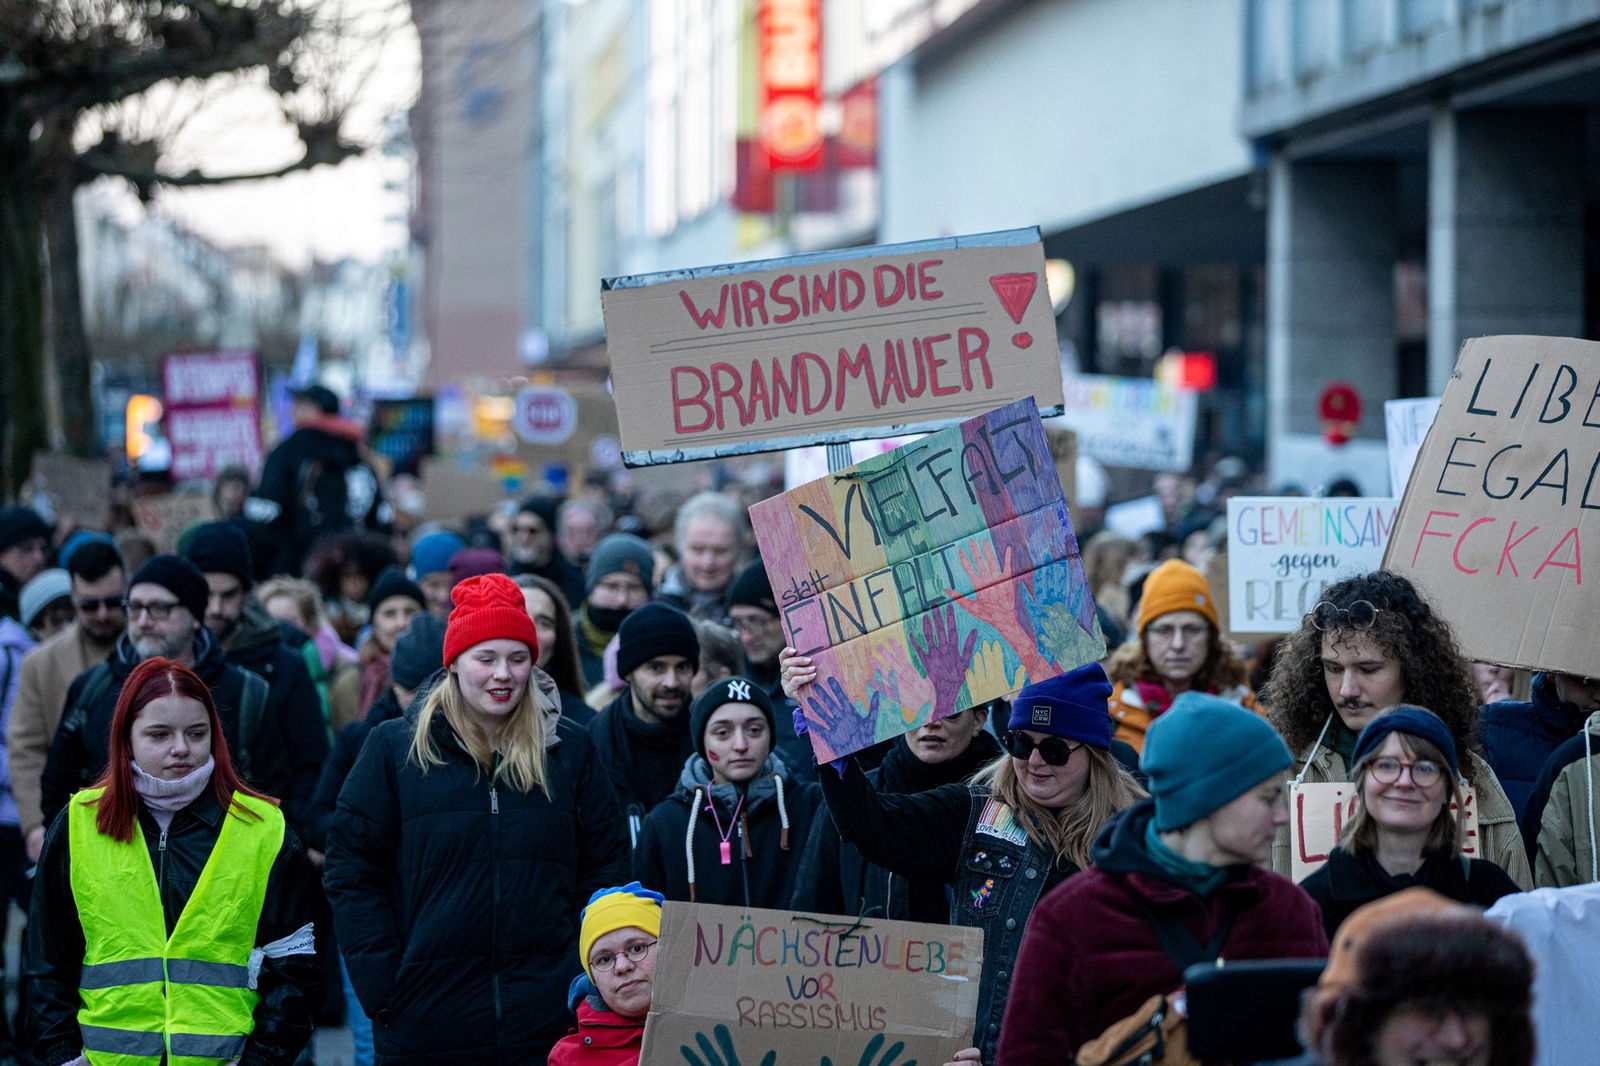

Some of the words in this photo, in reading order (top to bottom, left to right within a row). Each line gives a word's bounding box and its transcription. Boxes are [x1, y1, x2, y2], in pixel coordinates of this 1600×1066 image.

[874, 259, 944, 308] DIE
[670, 326, 993, 435] BRANDMAUER
[798, 415, 1039, 561] VIELFALT
[1236, 504, 1397, 548] GEMEINSAM
[1270, 552, 1341, 578] gegen
[781, 569, 830, 609] statt
[783, 543, 956, 657] EINFALT
[976, 824, 994, 834] LOVE
[693, 914, 969, 976] NÄCHSTENLIEBE
[785, 972, 838, 1002] VOR
[735, 996, 888, 1032] RASSISMUS
